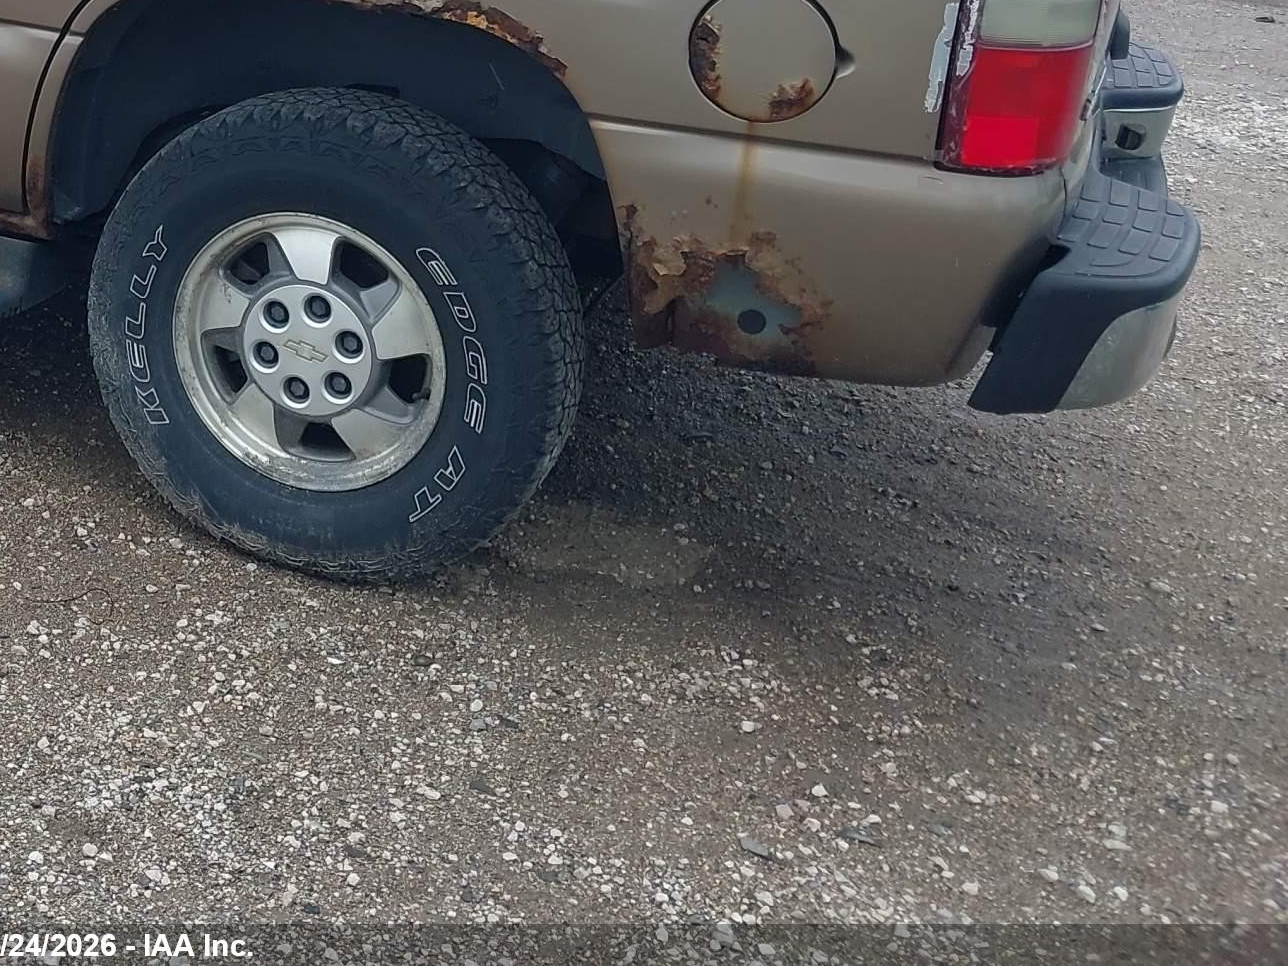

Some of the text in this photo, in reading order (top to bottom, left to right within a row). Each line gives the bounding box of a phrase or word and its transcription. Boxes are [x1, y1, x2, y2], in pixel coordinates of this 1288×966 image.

[125, 225, 169, 424] KELLY
[409, 248, 487, 522] EDGE AT
